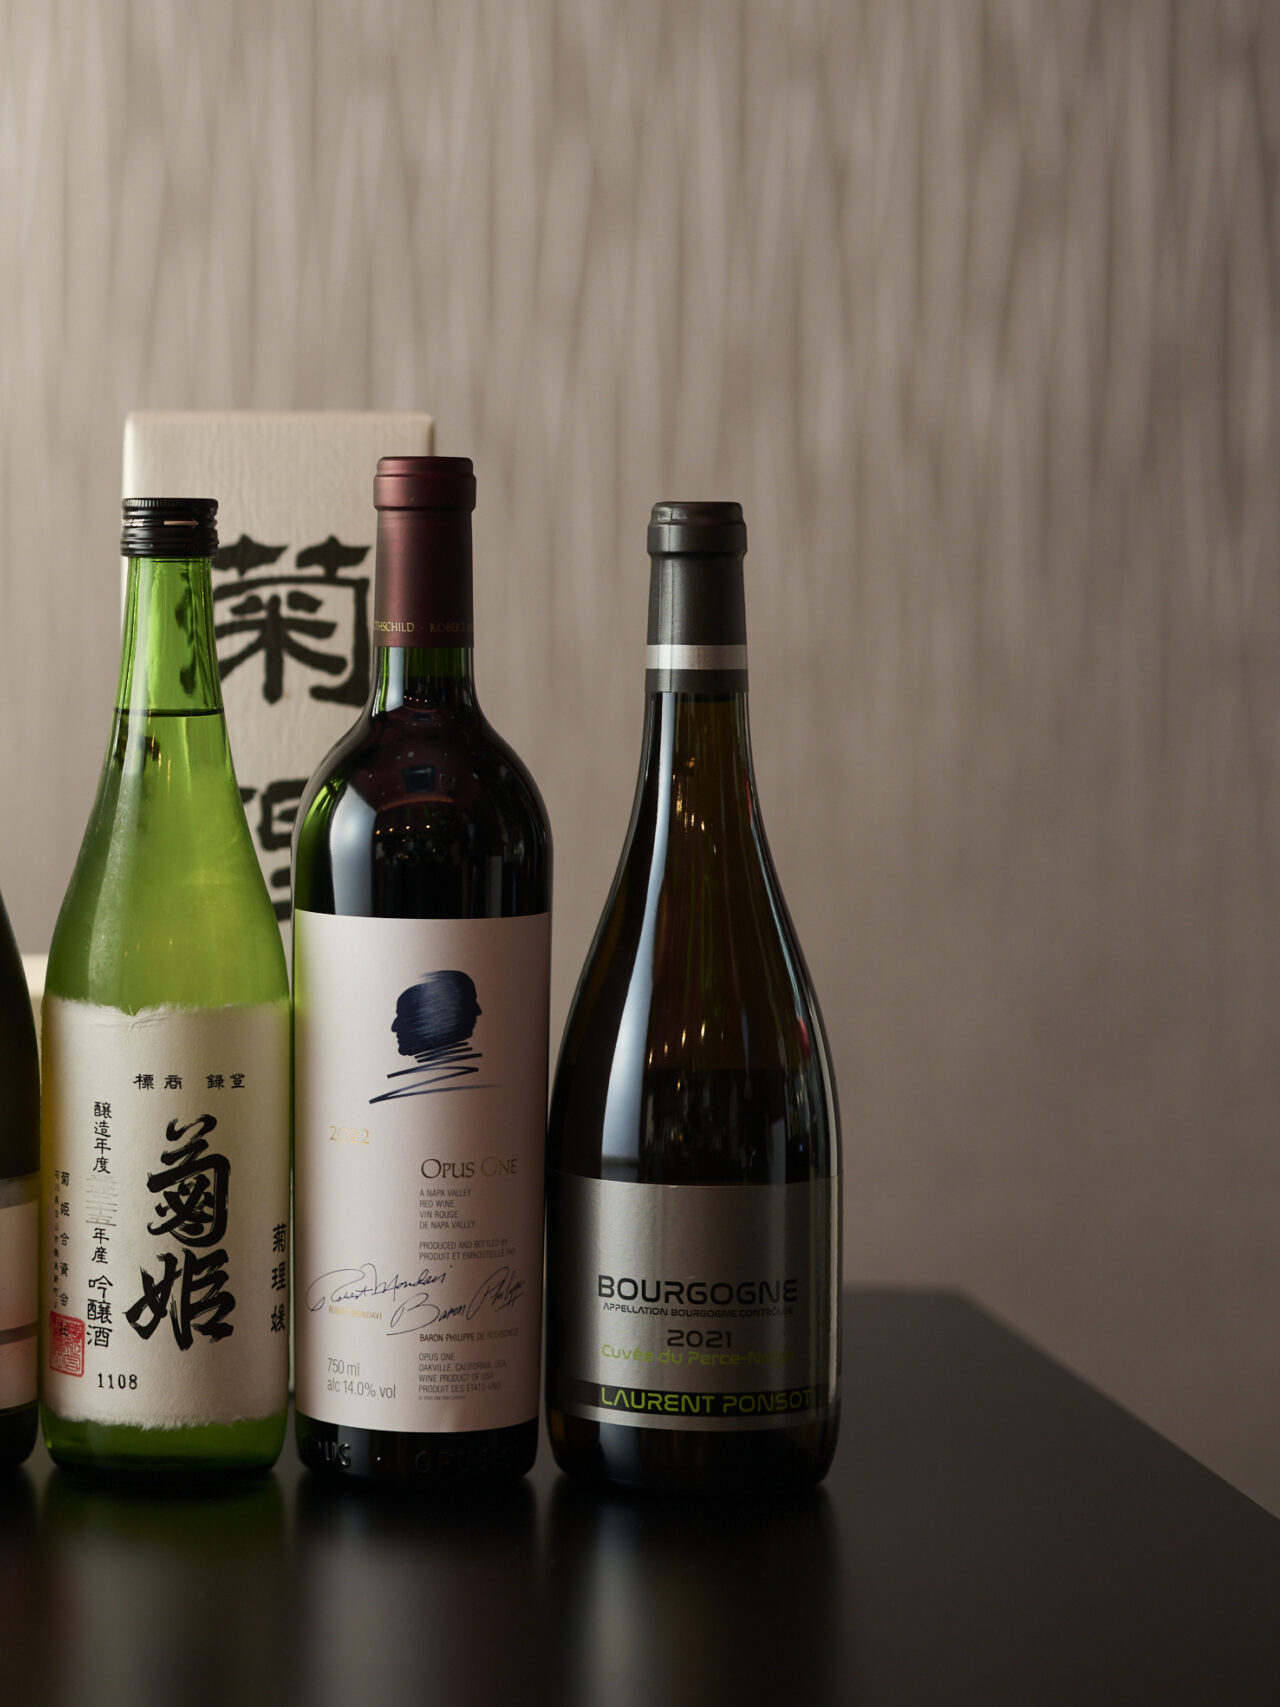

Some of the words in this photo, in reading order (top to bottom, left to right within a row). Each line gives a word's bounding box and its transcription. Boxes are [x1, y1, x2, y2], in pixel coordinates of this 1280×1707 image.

[419, 1189, 425, 1197] A
[426, 1189, 445, 1197] NAPA
[447, 1188, 472, 1197] VALLEY
[419, 1200, 433, 1208] RED
[436, 1200, 455, 1208] WINE
[419, 1210, 432, 1219] VIN
[434, 1210, 458, 1219] ROUGE
[419, 1221, 428, 1229] DE
[431, 1221, 449, 1229] NAPA
[451, 1220, 476, 1229] VALLEY
[419, 1241, 456, 1250] PRODUCED
[458, 1240, 472, 1249] AND
[419, 1252, 449, 1261] PRODUIT
[452, 1252, 460, 1260] ET
[597, 1274, 799, 1306] BOURGOGNE
[602, 1302, 669, 1317] APPELLATION
[670, 1307, 737, 1318] BOURGOGNE
[419, 1333, 444, 1342] BARON
[445, 1332, 475, 1342] PHILIPPE
[476, 1331, 485, 1340] DE
[666, 1329, 732, 1348] 2021
[419, 1353, 439, 1361] OPUS
[440, 1353, 455, 1361] ONE
[601, 1344, 654, 1364] Cuvée
[658, 1348, 683, 1365] du
[688, 1348, 794, 1367] Perce-N
[327, 1357, 344, 1375] 750
[347, 1362, 360, 1377] ml
[97, 1372, 138, 1390] 1108
[419, 1374, 437, 1383] WINE
[439, 1373, 469, 1382] PRODUCT
[471, 1372, 479, 1381] OF
[327, 1377, 340, 1392] alc
[344, 1380, 376, 1398] 14.0%
[379, 1383, 396, 1399] vol
[419, 1384, 449, 1393] PRODUIT
[451, 1384, 465, 1393] DES
[601, 1387, 715, 1414] LAURENT
[722, 1389, 812, 1414] PONSOT
